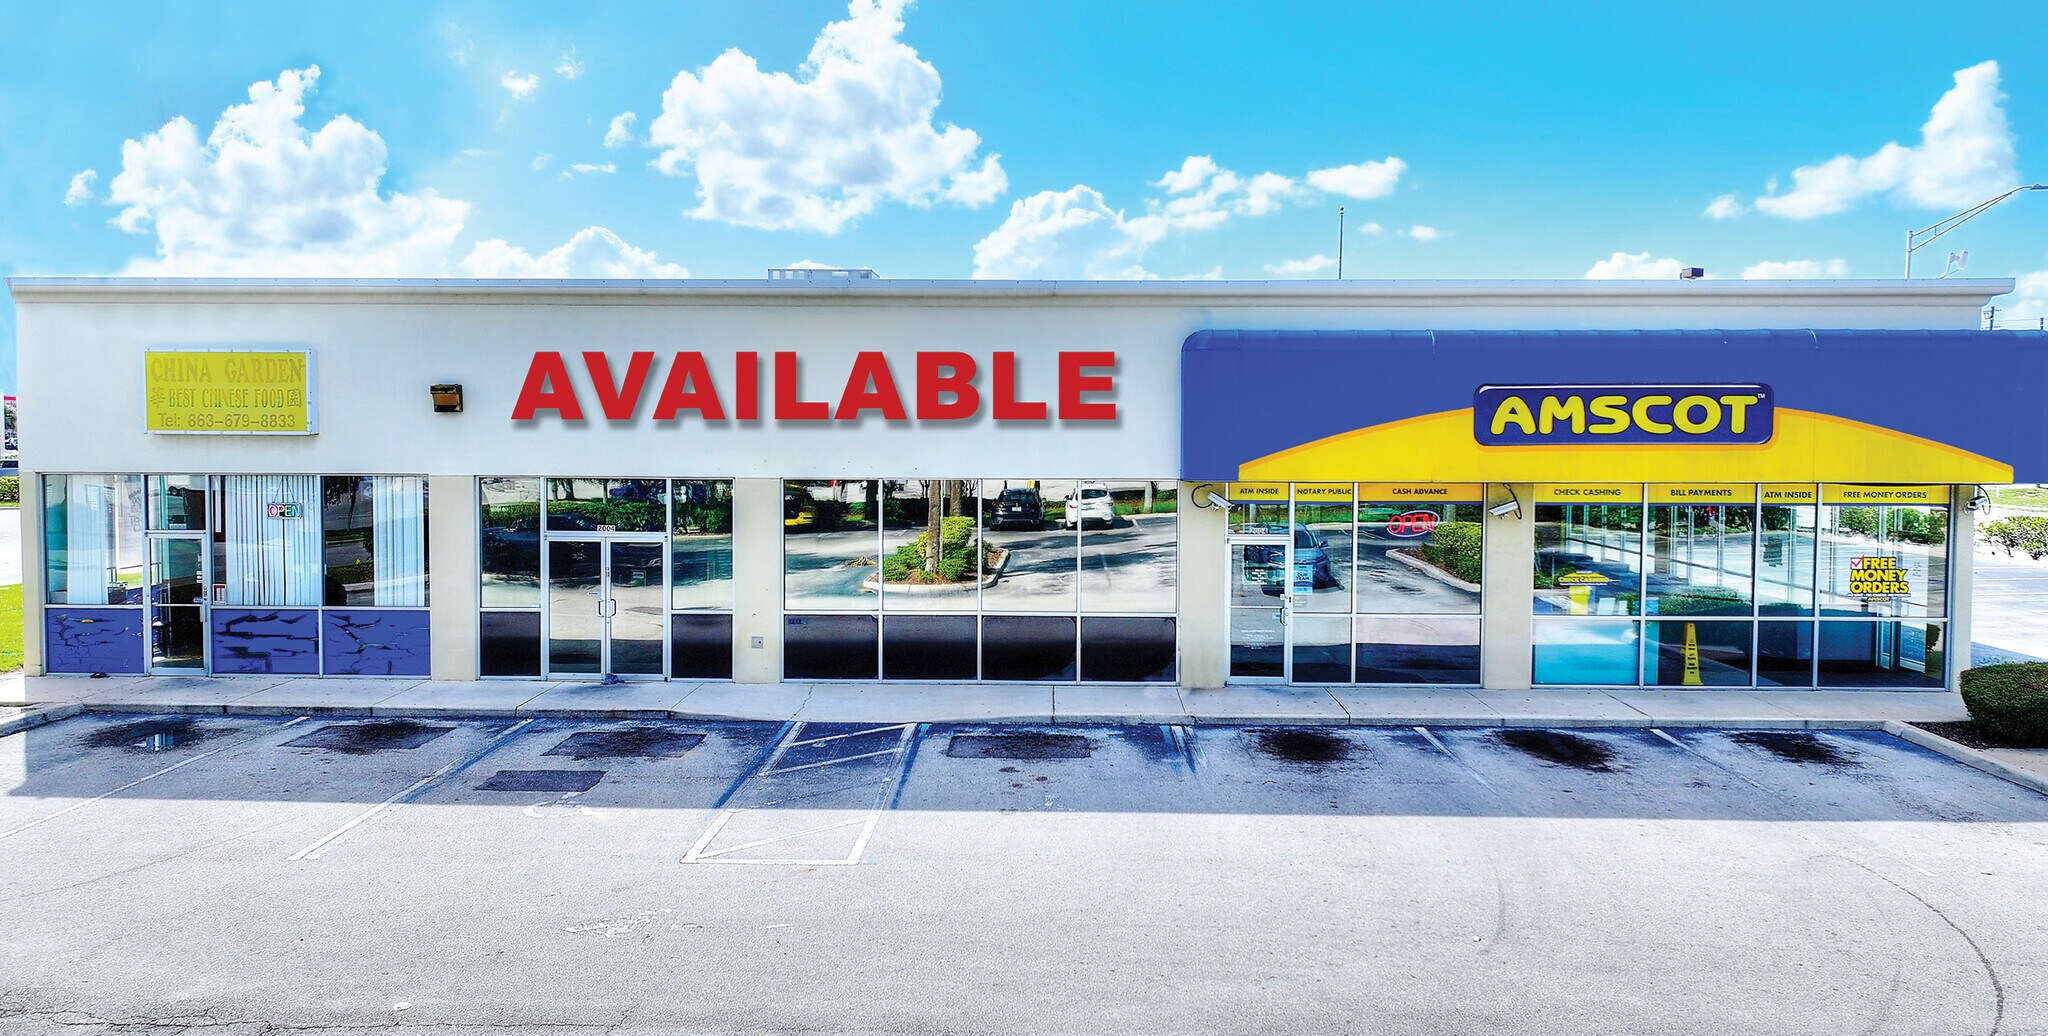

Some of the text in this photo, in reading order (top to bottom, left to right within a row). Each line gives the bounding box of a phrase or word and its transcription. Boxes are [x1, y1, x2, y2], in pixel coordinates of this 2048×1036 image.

[151, 358, 303, 383] CHINA GARDEN
[169, 388, 284, 408] BEST CHINESE FOOD
[158, 413, 296, 428] Tel: 863-679-8833
[1490, 395, 1760, 436] AMSCOT
[1554, 488, 1622, 497] CHECK CASHING
[1670, 489, 1732, 497] BILL PAYMENTS
[1764, 491, 1812, 499] ATM INSIDE
[1895, 491, 1927, 499] ORDERS
[268, 504, 300, 517] OPEN
[1387, 513, 1437, 533] OPEN
[1863, 557, 1897, 569] FREE
[1850, 569, 1908, 582] MONEY
[1850, 581, 1909, 594] ORDERS
